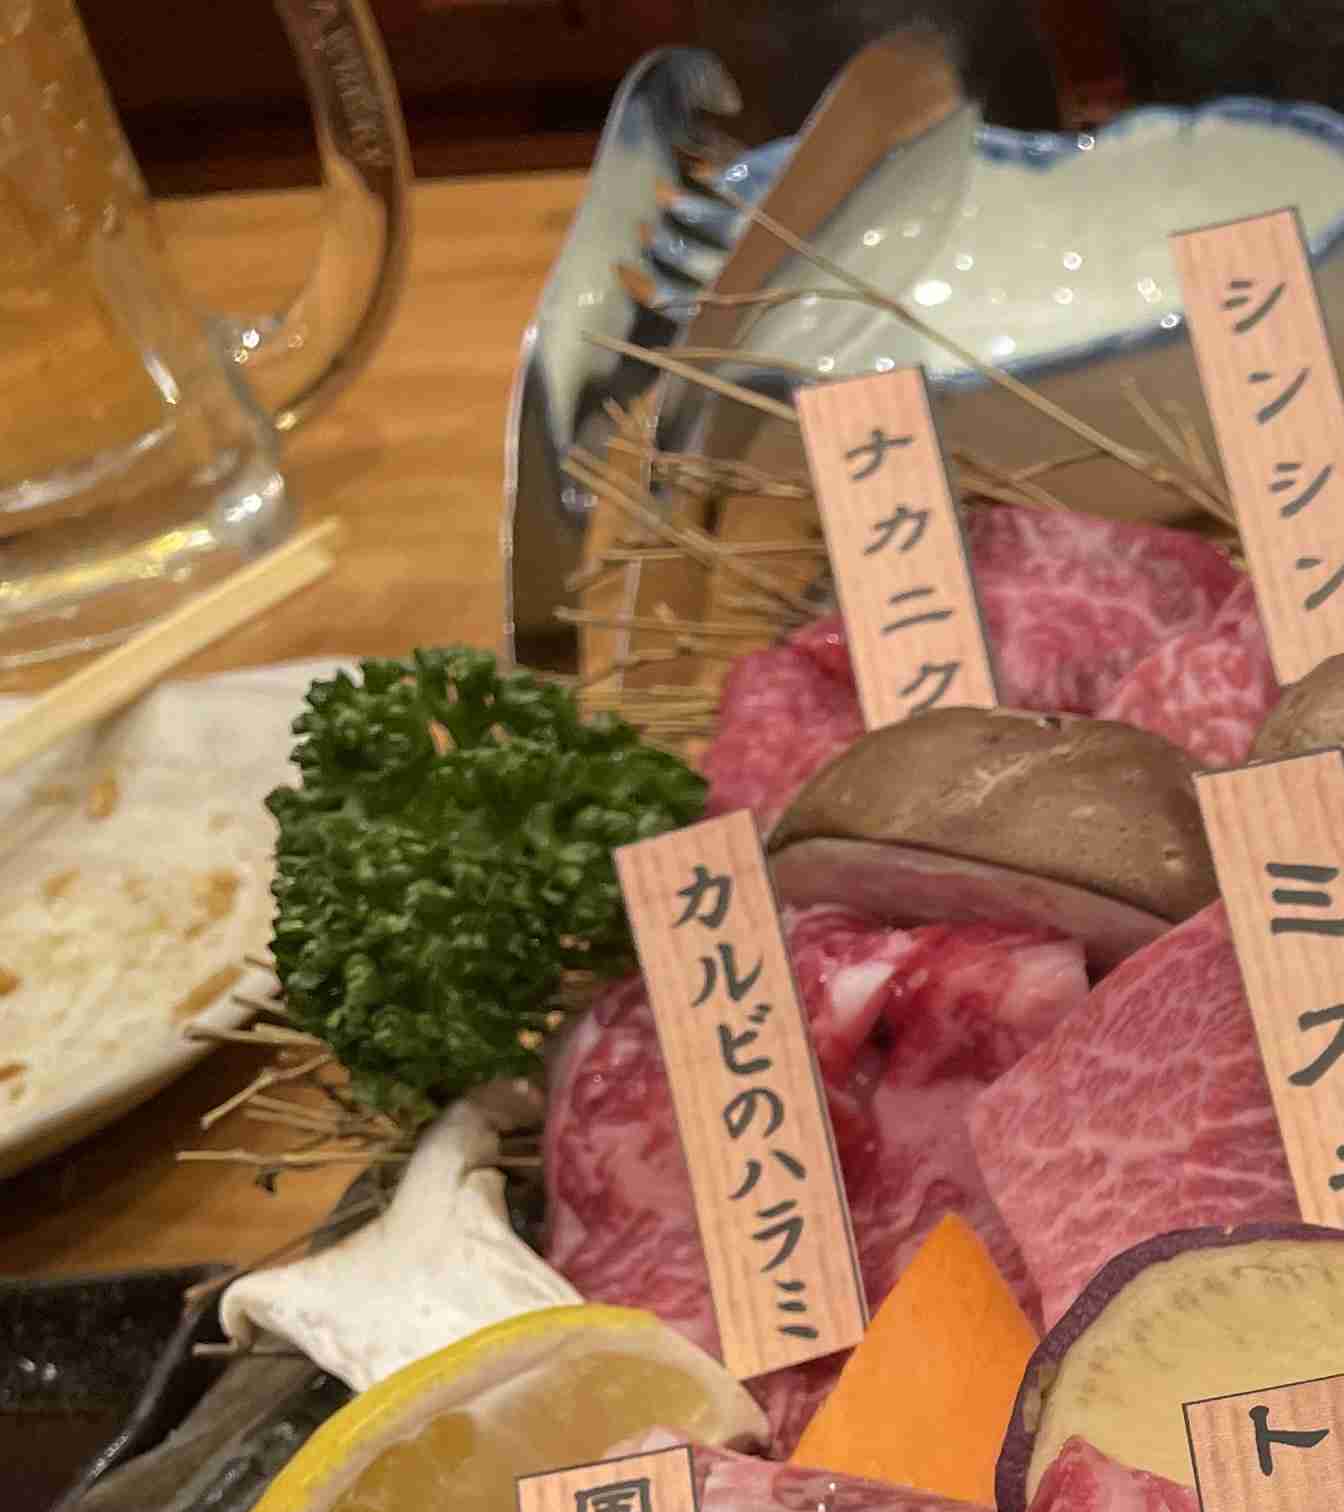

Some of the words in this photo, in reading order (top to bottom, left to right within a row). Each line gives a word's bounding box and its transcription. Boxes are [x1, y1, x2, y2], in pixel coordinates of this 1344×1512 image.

[845, 429, 959, 708] ナカニク
[671, 865, 819, 1340] カルビのハラミ
